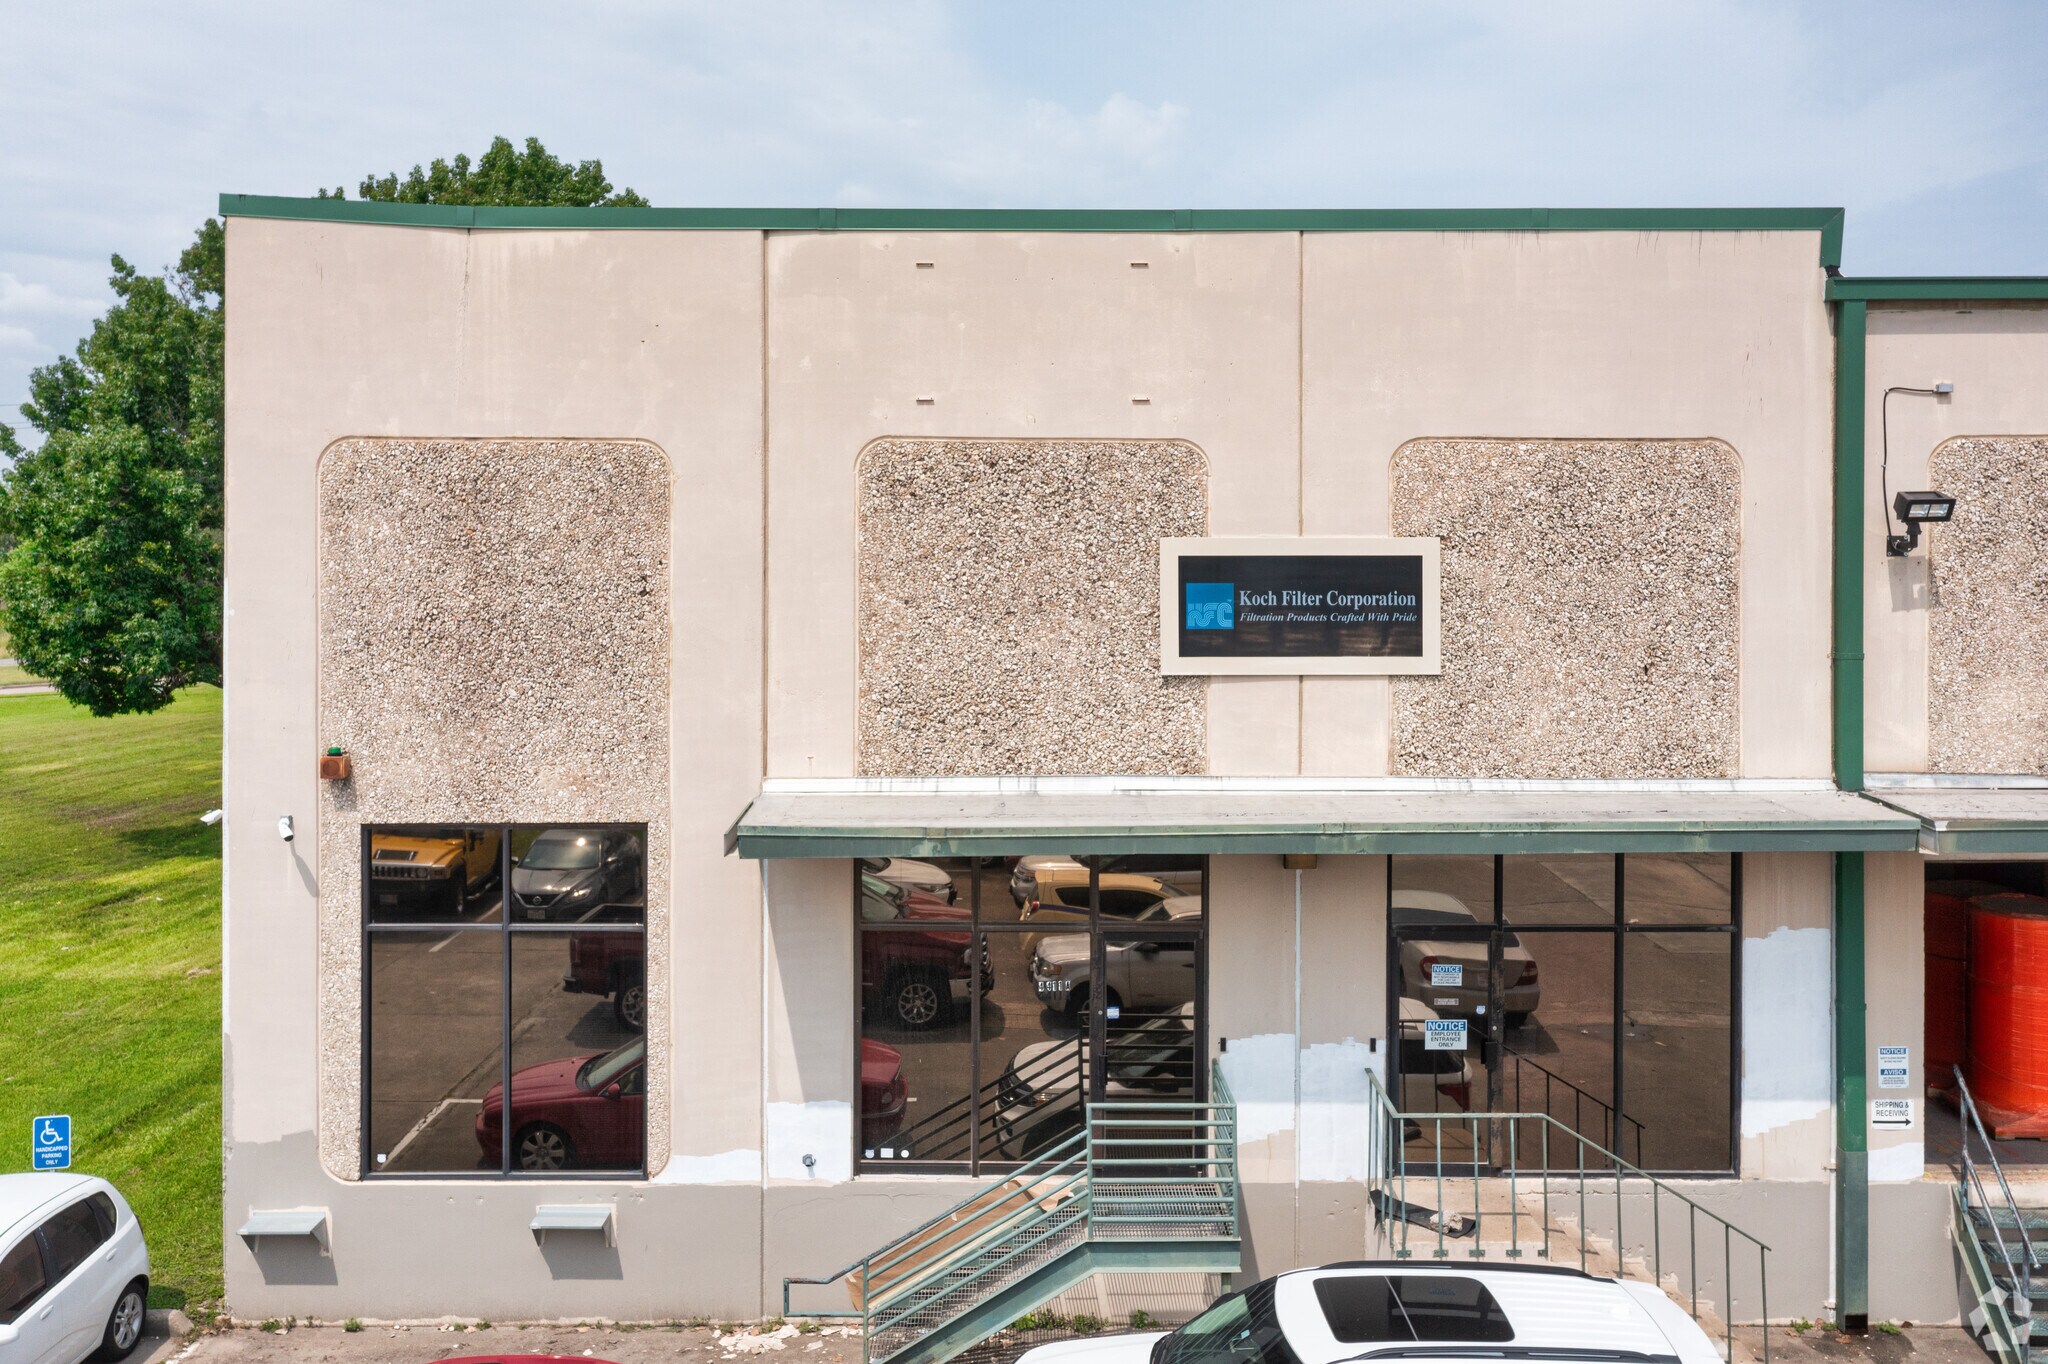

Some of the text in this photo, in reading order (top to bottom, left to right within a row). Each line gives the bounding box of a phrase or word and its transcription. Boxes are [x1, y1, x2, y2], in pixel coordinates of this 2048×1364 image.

[1239, 590, 1417, 610] Koch Filter Corporation
[1239, 612, 1417, 624] Filtration Products Crafted With Pride
[1427, 1022, 1465, 1031] NOTICE
